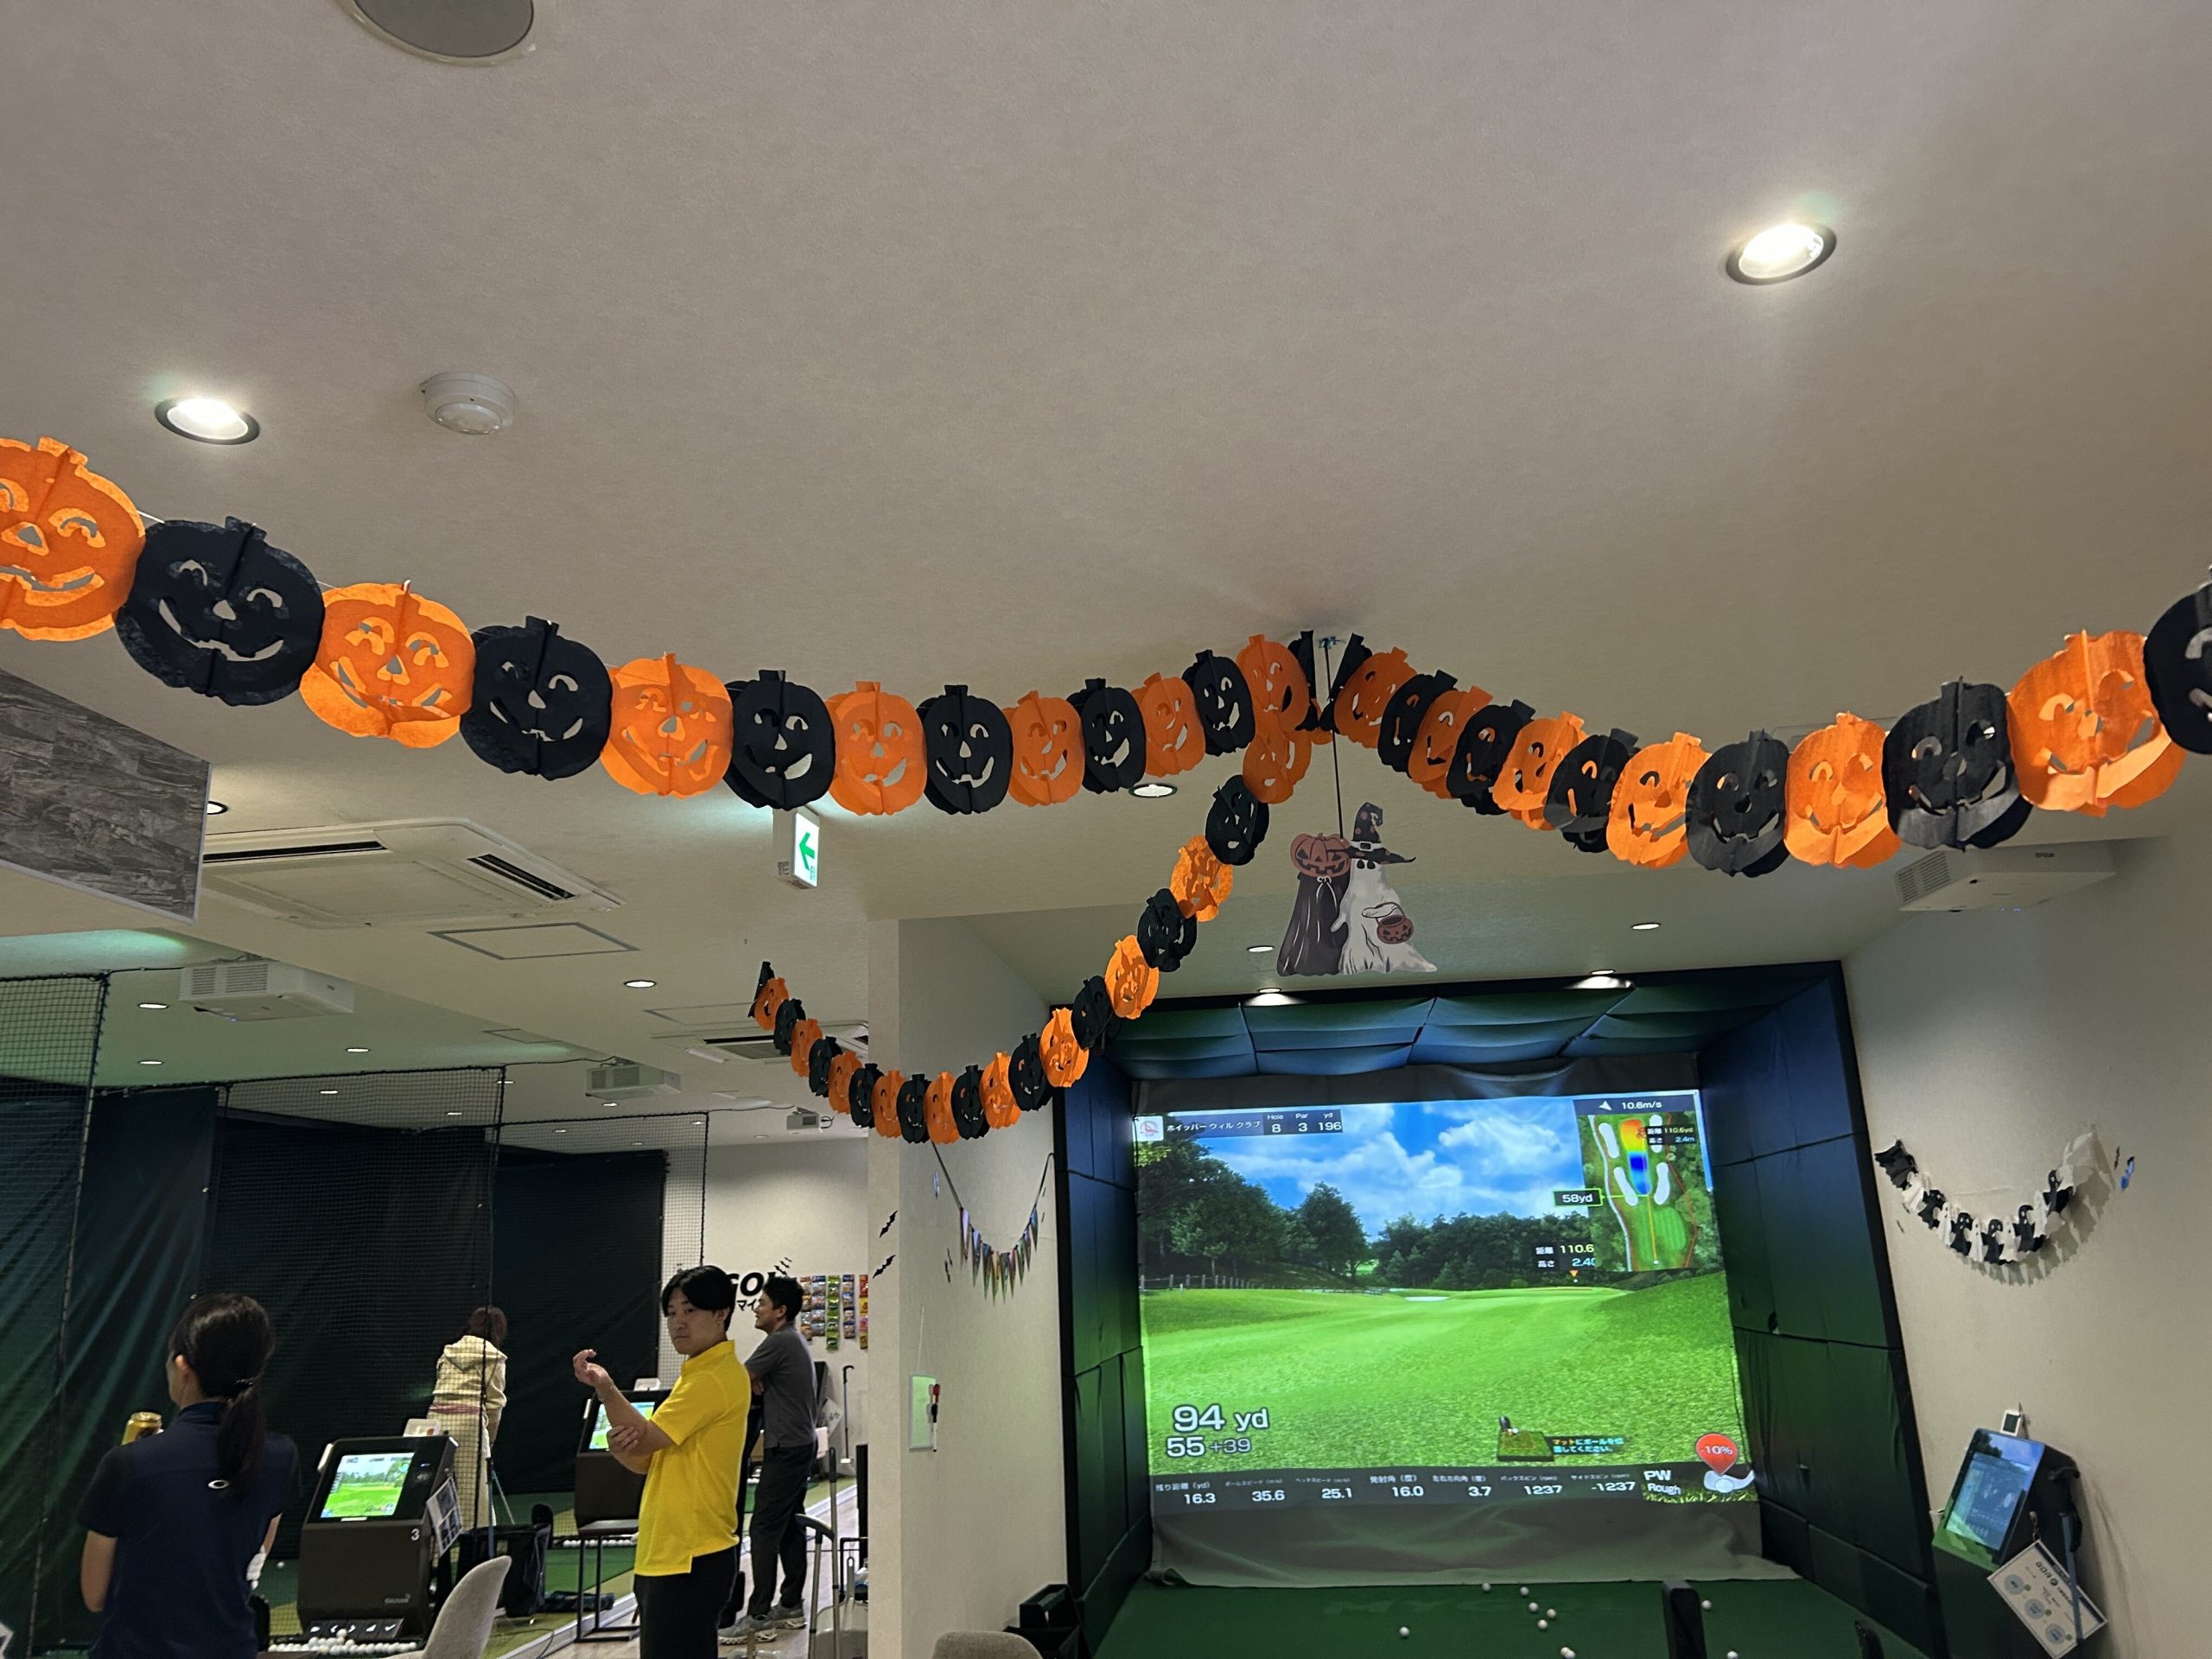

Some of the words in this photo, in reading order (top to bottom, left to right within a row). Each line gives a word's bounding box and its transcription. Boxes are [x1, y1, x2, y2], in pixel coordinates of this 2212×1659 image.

[1621, 1101, 1663, 1109] 10.6m/s
[1271, 1123, 1282, 1134] 8
[1298, 1122, 1308, 1132] 3
[1318, 1122, 1342, 1131] 196
[1562, 1193, 1593, 1204] 58yd
[1560, 1244, 1595, 1254] 110.6
[1173, 1404, 1226, 1433] 94
[1234, 1407, 1269, 1432] yd
[1166, 1436, 1205, 1458] 55
[1210, 1438, 1252, 1453] +39
[1700, 1444, 1733, 1455] -10%
[1643, 1470, 1672, 1481] PW
[1391, 1485, 1425, 1497] 16.0
[1467, 1485, 1492, 1497] 3.7
[1523, 1484, 1563, 1495] 1237
[1591, 1481, 1637, 1491] -1237
[1647, 1482, 1682, 1496] Rough
[1184, 1492, 1217, 1504] 16.3
[1251, 1490, 1286, 1502] 35.6
[1321, 1487, 1353, 1499] 25.1
[410, 1528, 420, 1541] 3
